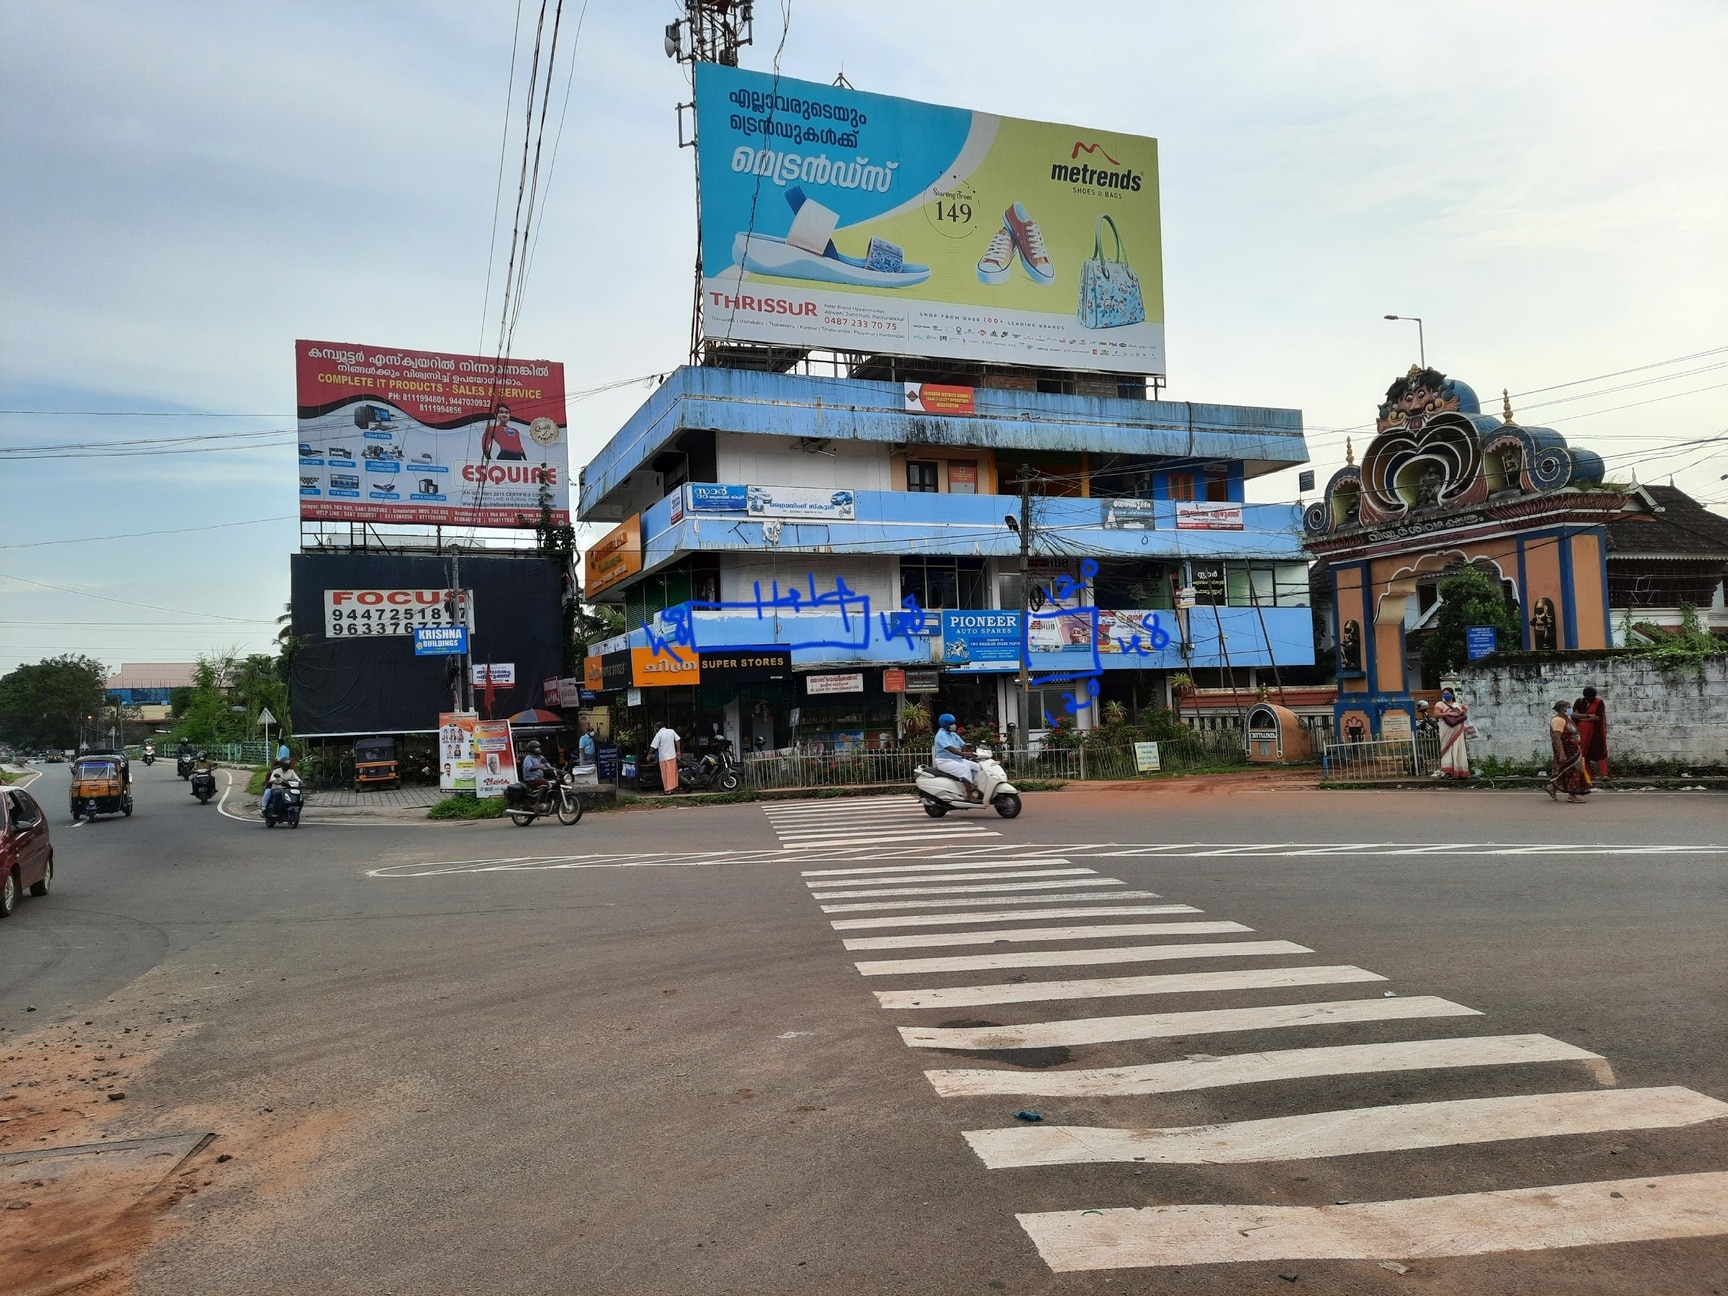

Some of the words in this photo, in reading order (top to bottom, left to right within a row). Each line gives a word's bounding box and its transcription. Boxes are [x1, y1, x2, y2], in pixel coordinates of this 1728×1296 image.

[729, 88, 867, 128] എല്ലാവരുടെയും
[1051, 163, 1142, 193] metrends
[932, 187, 956, 200] Starting
[1073, 186, 1096, 197] SHOES
[1104, 191, 1123, 200] BAGS
[936, 200, 972, 224] 149
[709, 292, 818, 317] THRISSUR
[824, 316, 848, 326] 0487
[851, 318, 868, 328] 233
[871, 320, 883, 329] 70
[886, 322, 897, 331] 75
[1007, 320, 1036, 328] LEADING
[317, 373, 374, 388] COMPLETE
[376, 379, 387, 389] IT
[389, 380, 444, 393] PRODUCTS
[452, 384, 486, 396] SALES
[498, 387, 542, 399] SERVICE
[388, 392, 401, 400] PH:
[462, 464, 557, 485] ESQUIRE
[1046, 557, 1069, 568] HUB
[332, 591, 466, 606] FOCUS
[949, 615, 1018, 628] PIONEER
[1041, 622, 1056, 631] HUB
[418, 628, 463, 640] KRISHNA
[423, 640, 459, 648] BUILDINGS
[701, 658, 738, 669] SUPER
[740, 657, 784, 668] STORES
